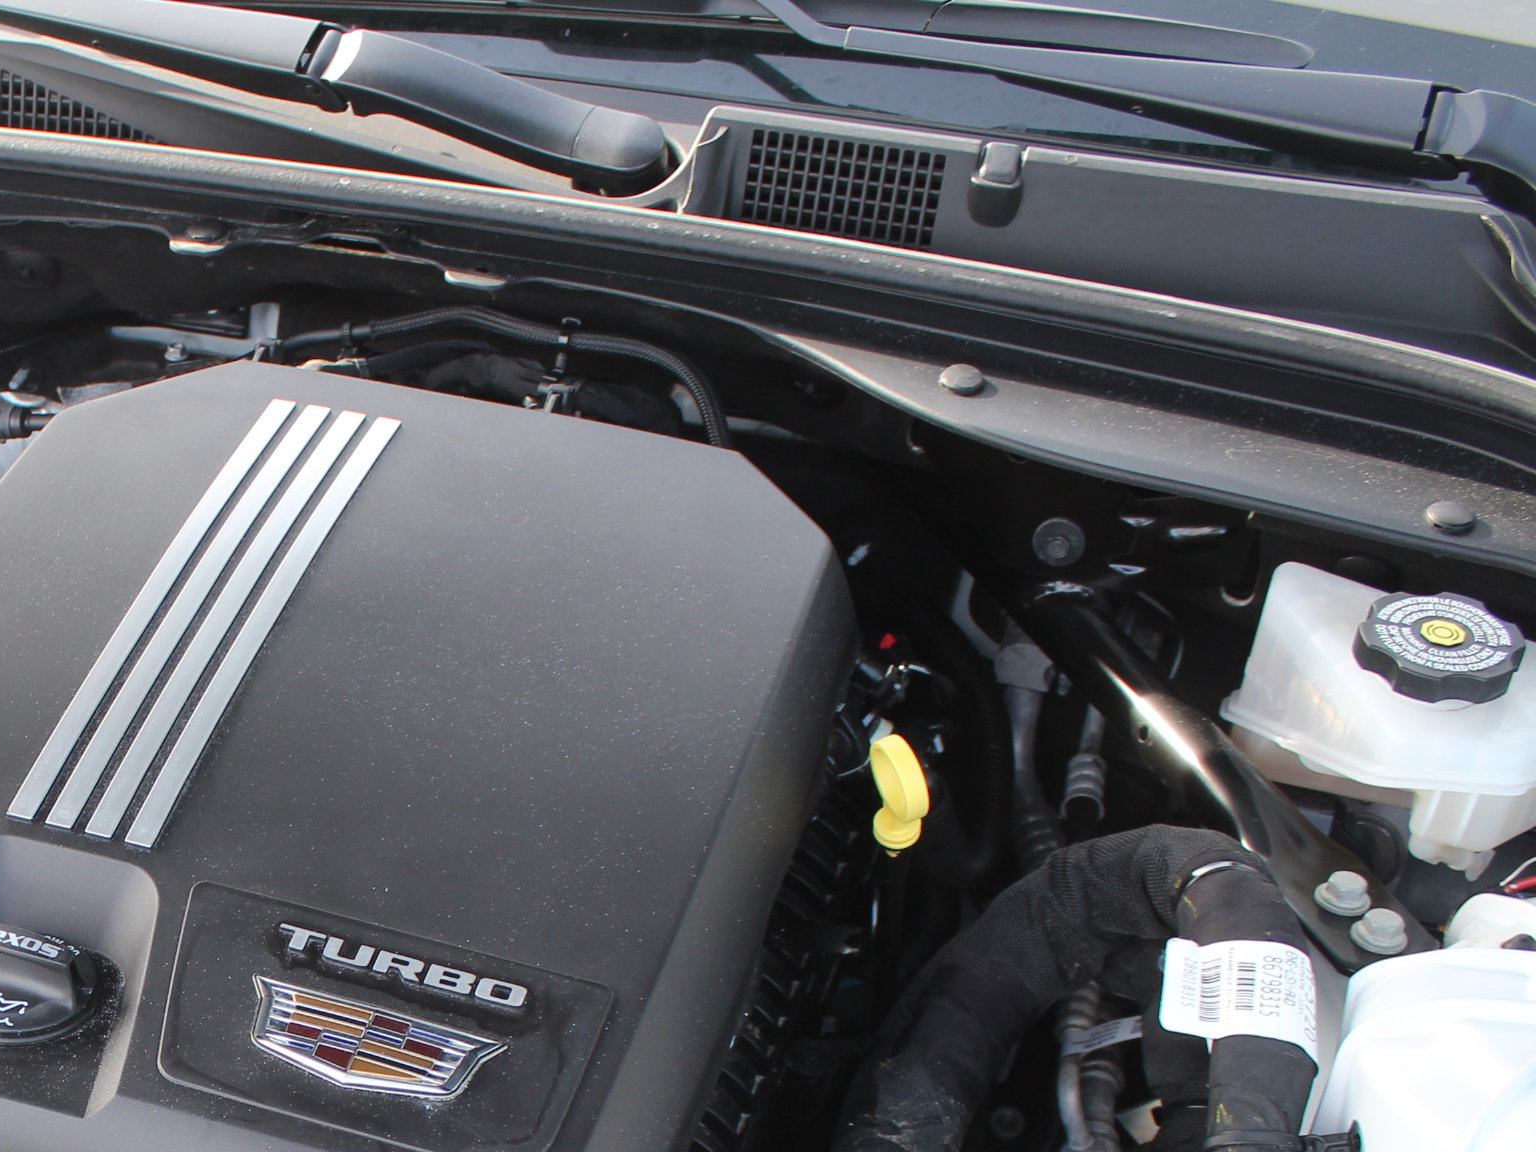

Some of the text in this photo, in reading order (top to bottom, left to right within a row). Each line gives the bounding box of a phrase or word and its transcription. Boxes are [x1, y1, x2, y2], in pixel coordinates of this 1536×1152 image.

[1381, 638, 1404, 653] FLUID
[1398, 651, 1425, 665] FROM
[1392, 636, 1420, 654] BEFORE
[1426, 647, 1459, 657] CLEAN
[279, 922, 528, 1007] TURBO
[1259, 955, 1283, 1018] 86798315
